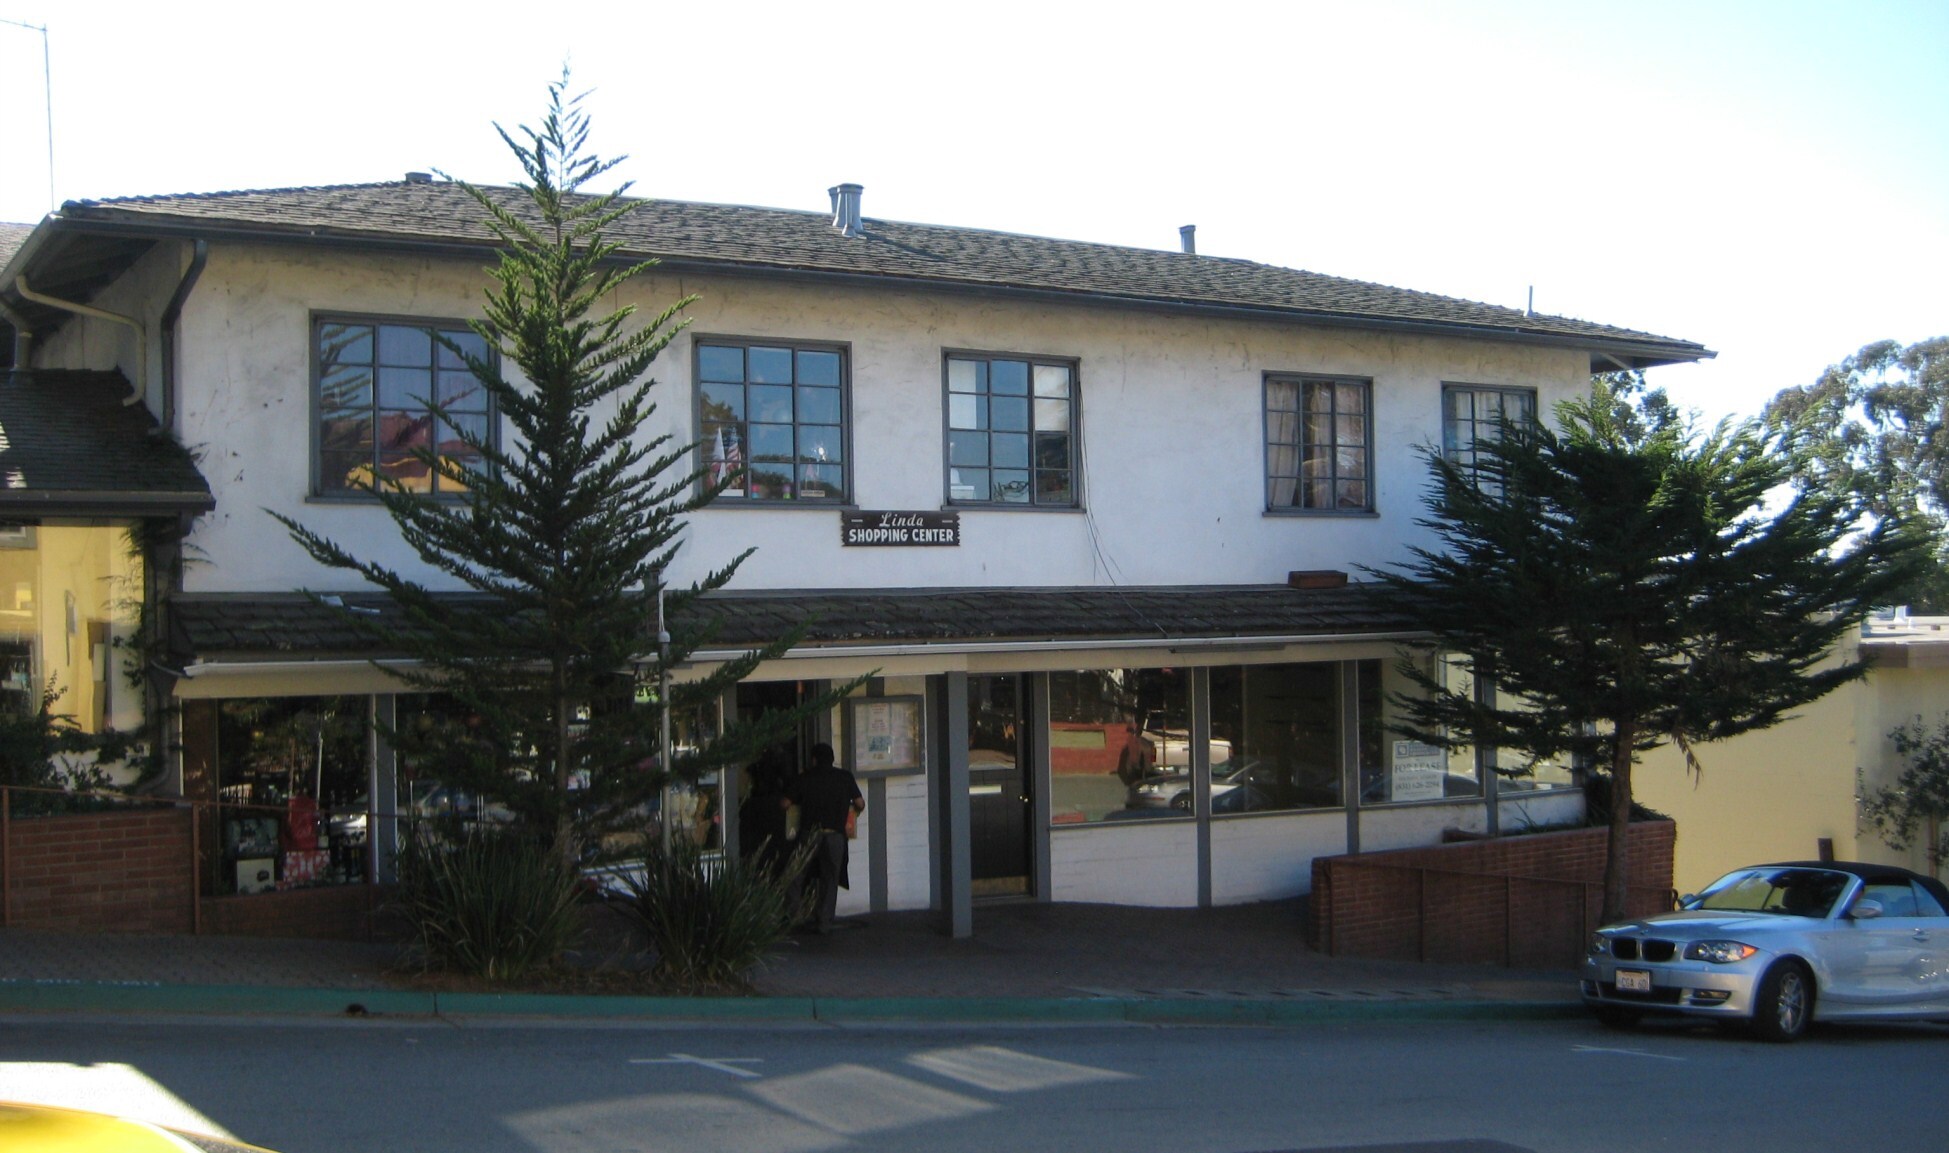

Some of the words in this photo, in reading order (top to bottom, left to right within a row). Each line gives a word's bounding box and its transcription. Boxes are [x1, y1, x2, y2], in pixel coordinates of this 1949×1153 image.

[879, 512, 924, 527] Linda
[849, 528, 908, 542] SHOPPING
[912, 528, 954, 542] CENTER
